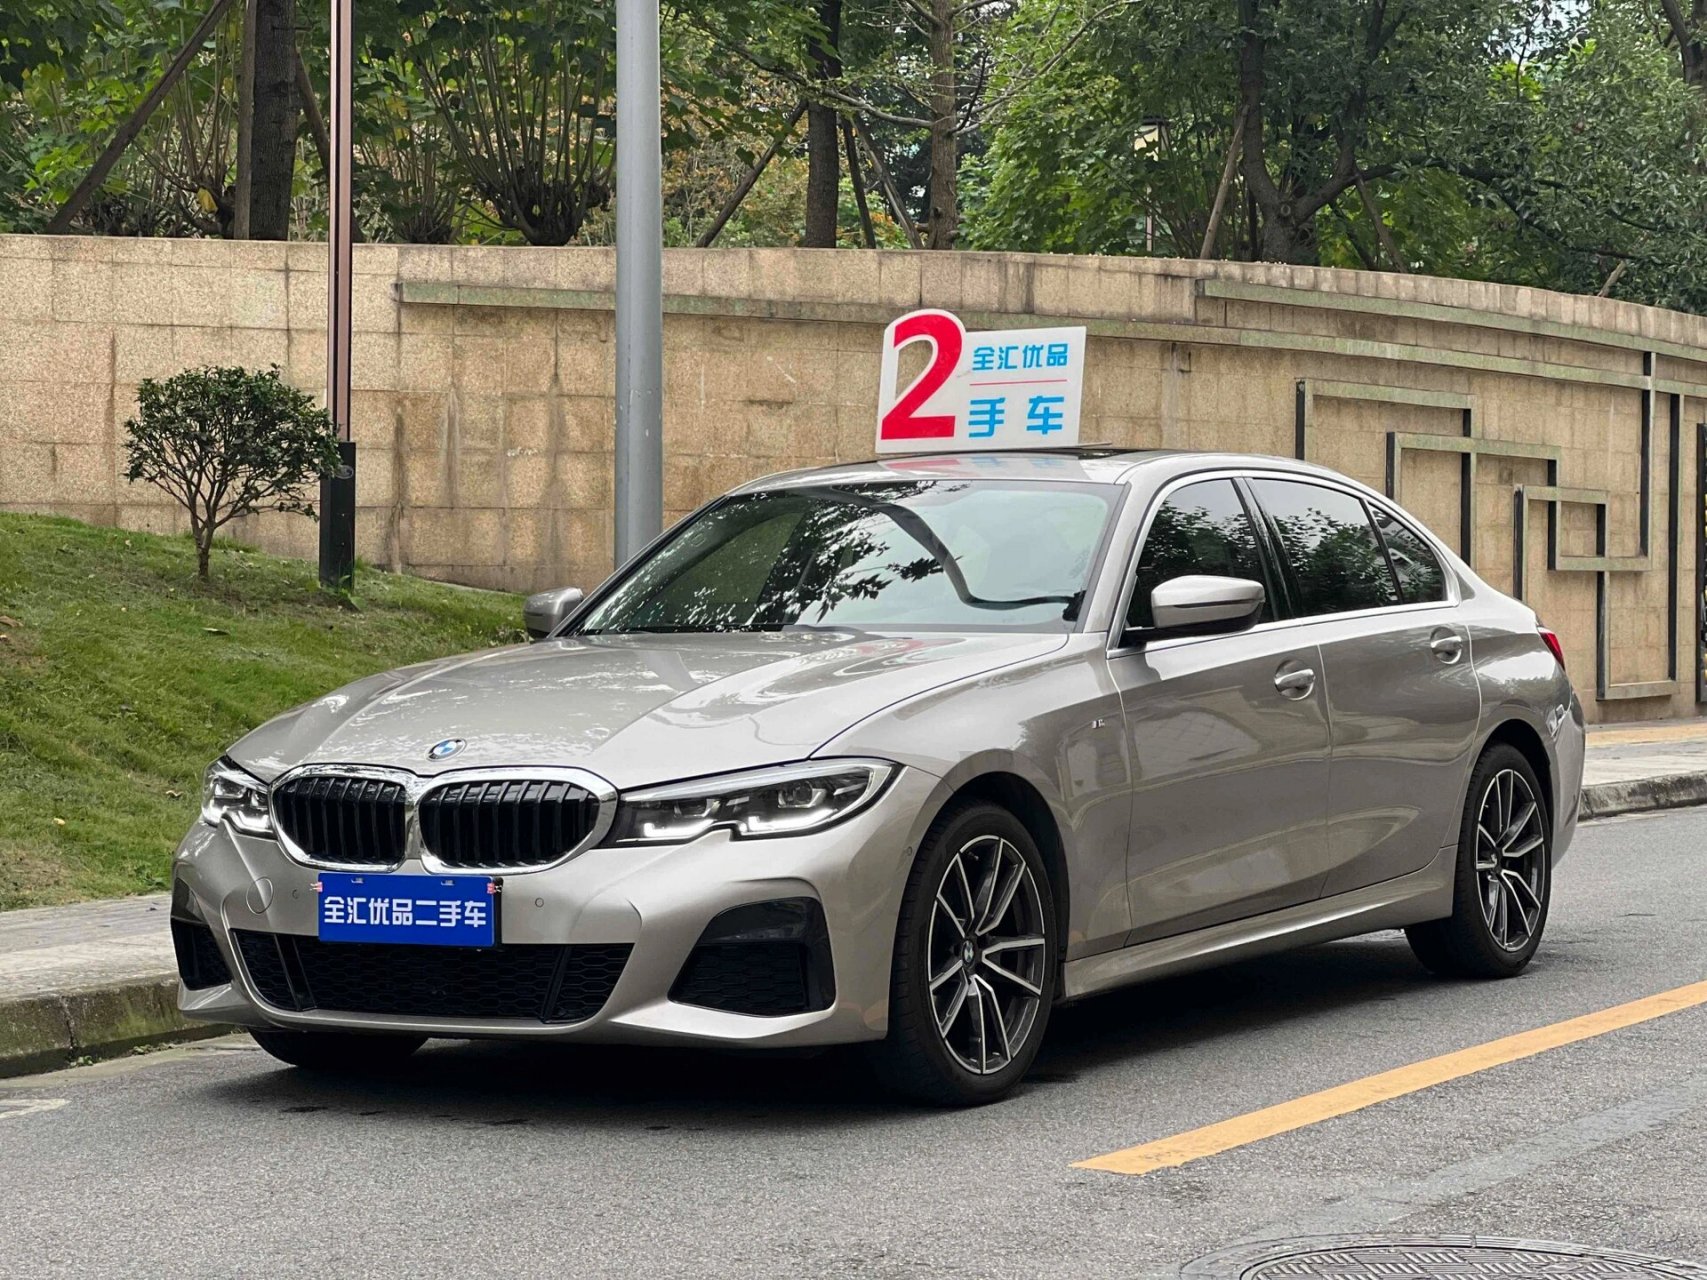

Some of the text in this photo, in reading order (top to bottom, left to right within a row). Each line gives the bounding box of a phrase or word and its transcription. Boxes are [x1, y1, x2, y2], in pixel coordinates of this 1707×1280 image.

[972, 343, 1069, 371] 全汇优品
[880, 314, 963, 440] 2
[324, 896, 487, 928] 全汇优品二手车
